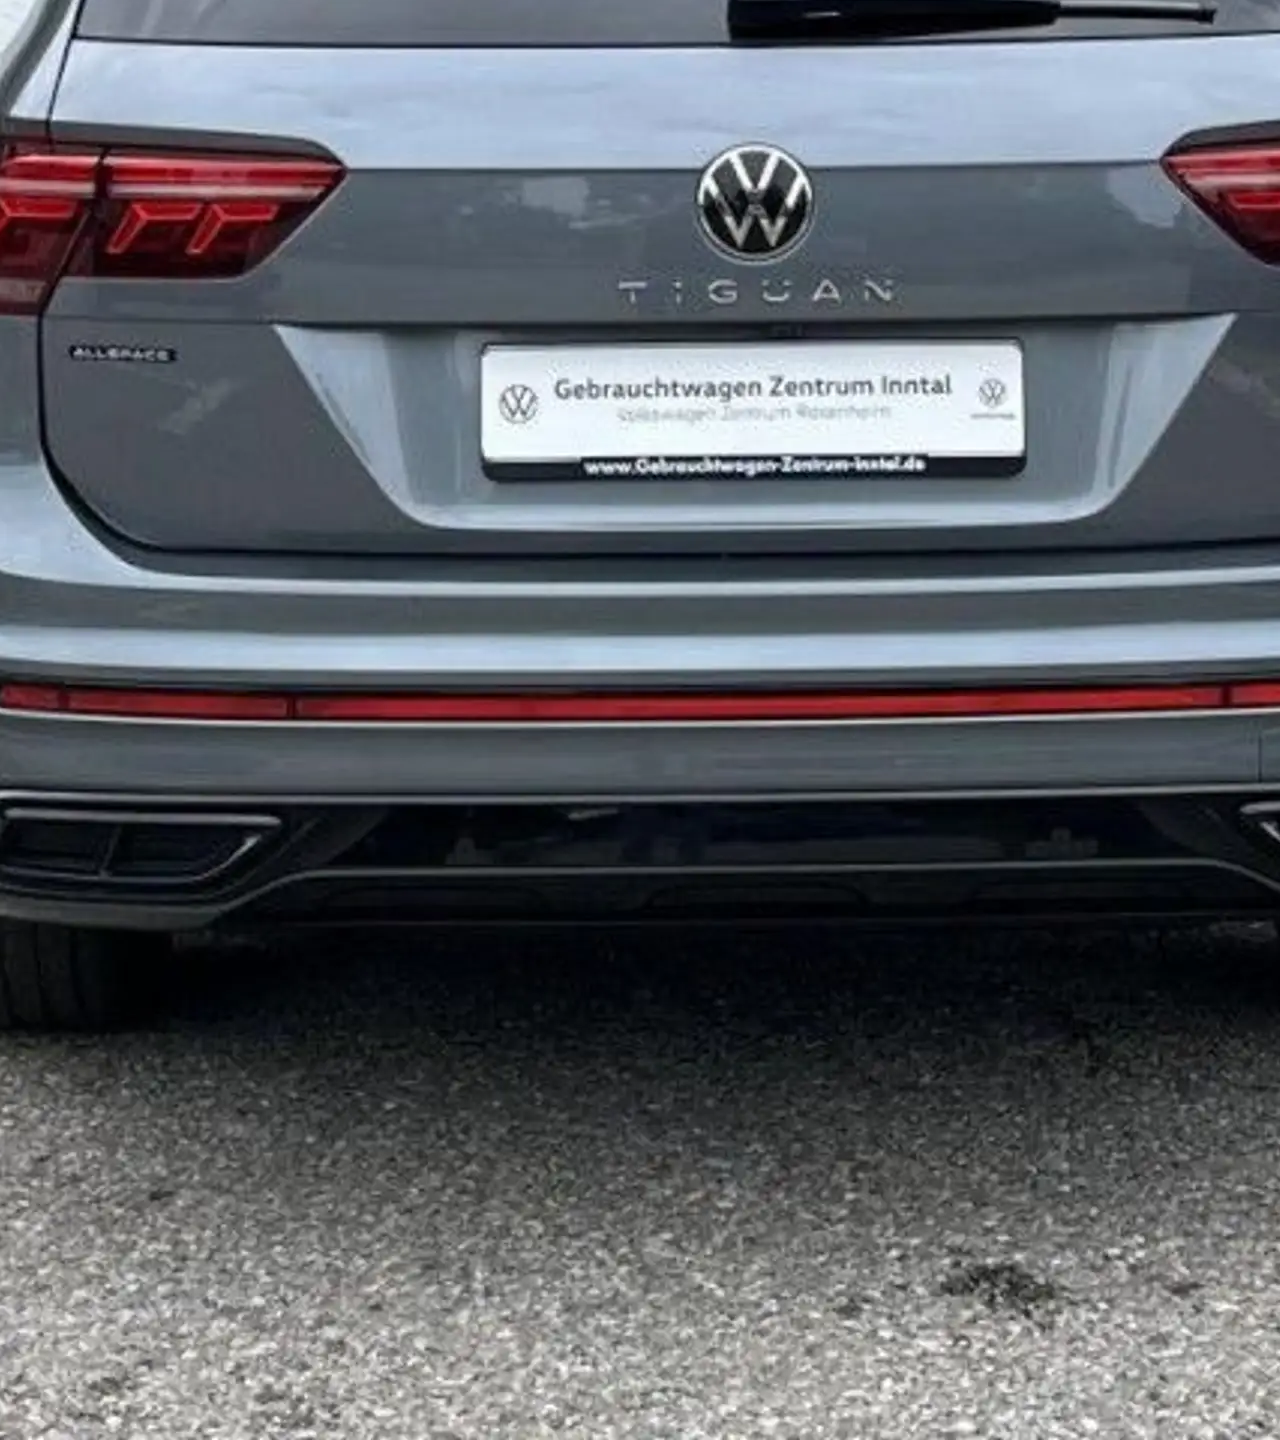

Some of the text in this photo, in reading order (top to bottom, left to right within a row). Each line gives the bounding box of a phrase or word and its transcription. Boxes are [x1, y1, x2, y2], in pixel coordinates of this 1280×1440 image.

[618, 279, 893, 304] TIGUAN
[553, 373, 953, 403] Gebrauchtwagen Zentrum Inntal
